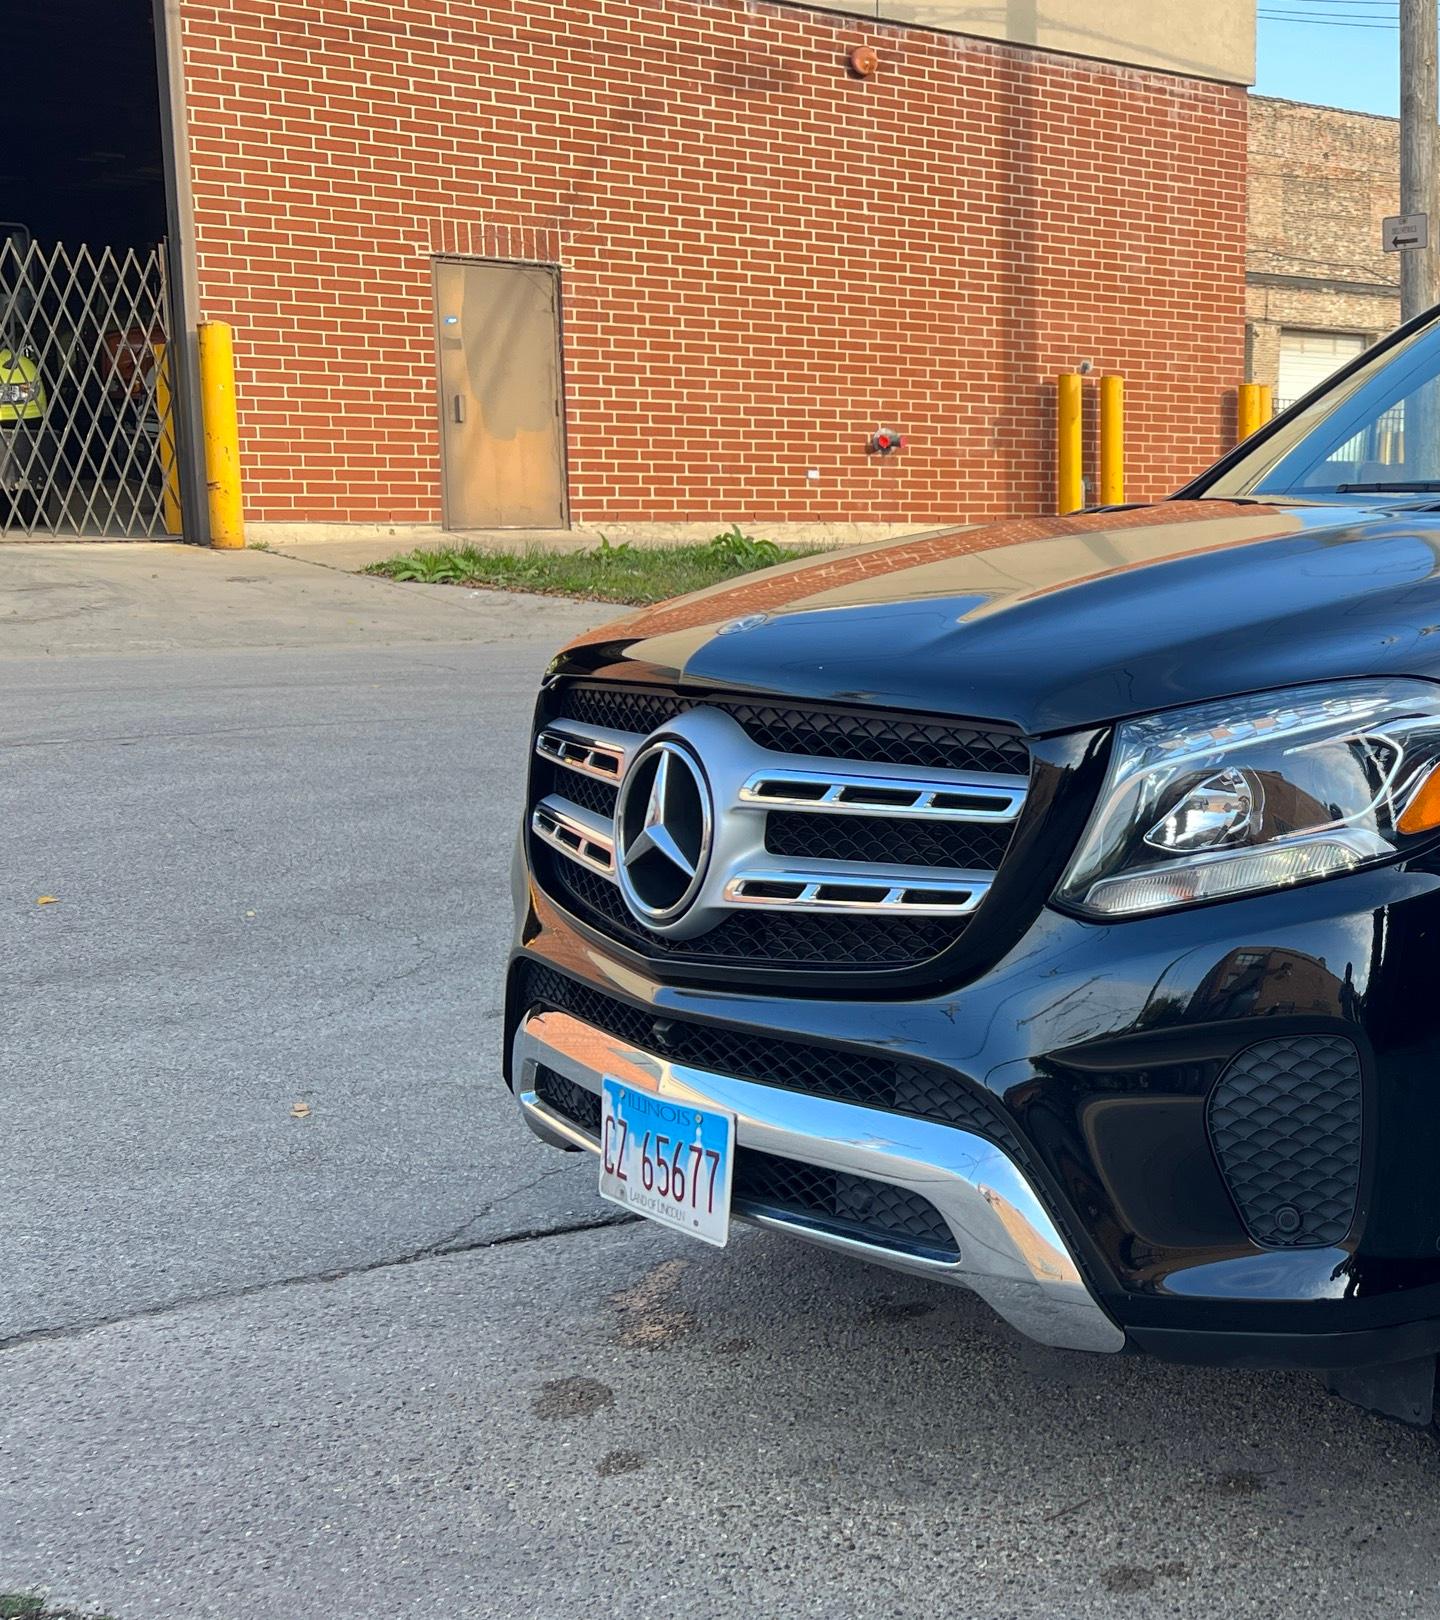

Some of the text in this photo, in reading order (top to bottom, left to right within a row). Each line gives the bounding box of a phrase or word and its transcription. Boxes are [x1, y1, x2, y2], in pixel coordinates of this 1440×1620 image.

[628, 1092, 690, 1126] ILLINOIS
[604, 1115, 720, 1213] CZ 65677
